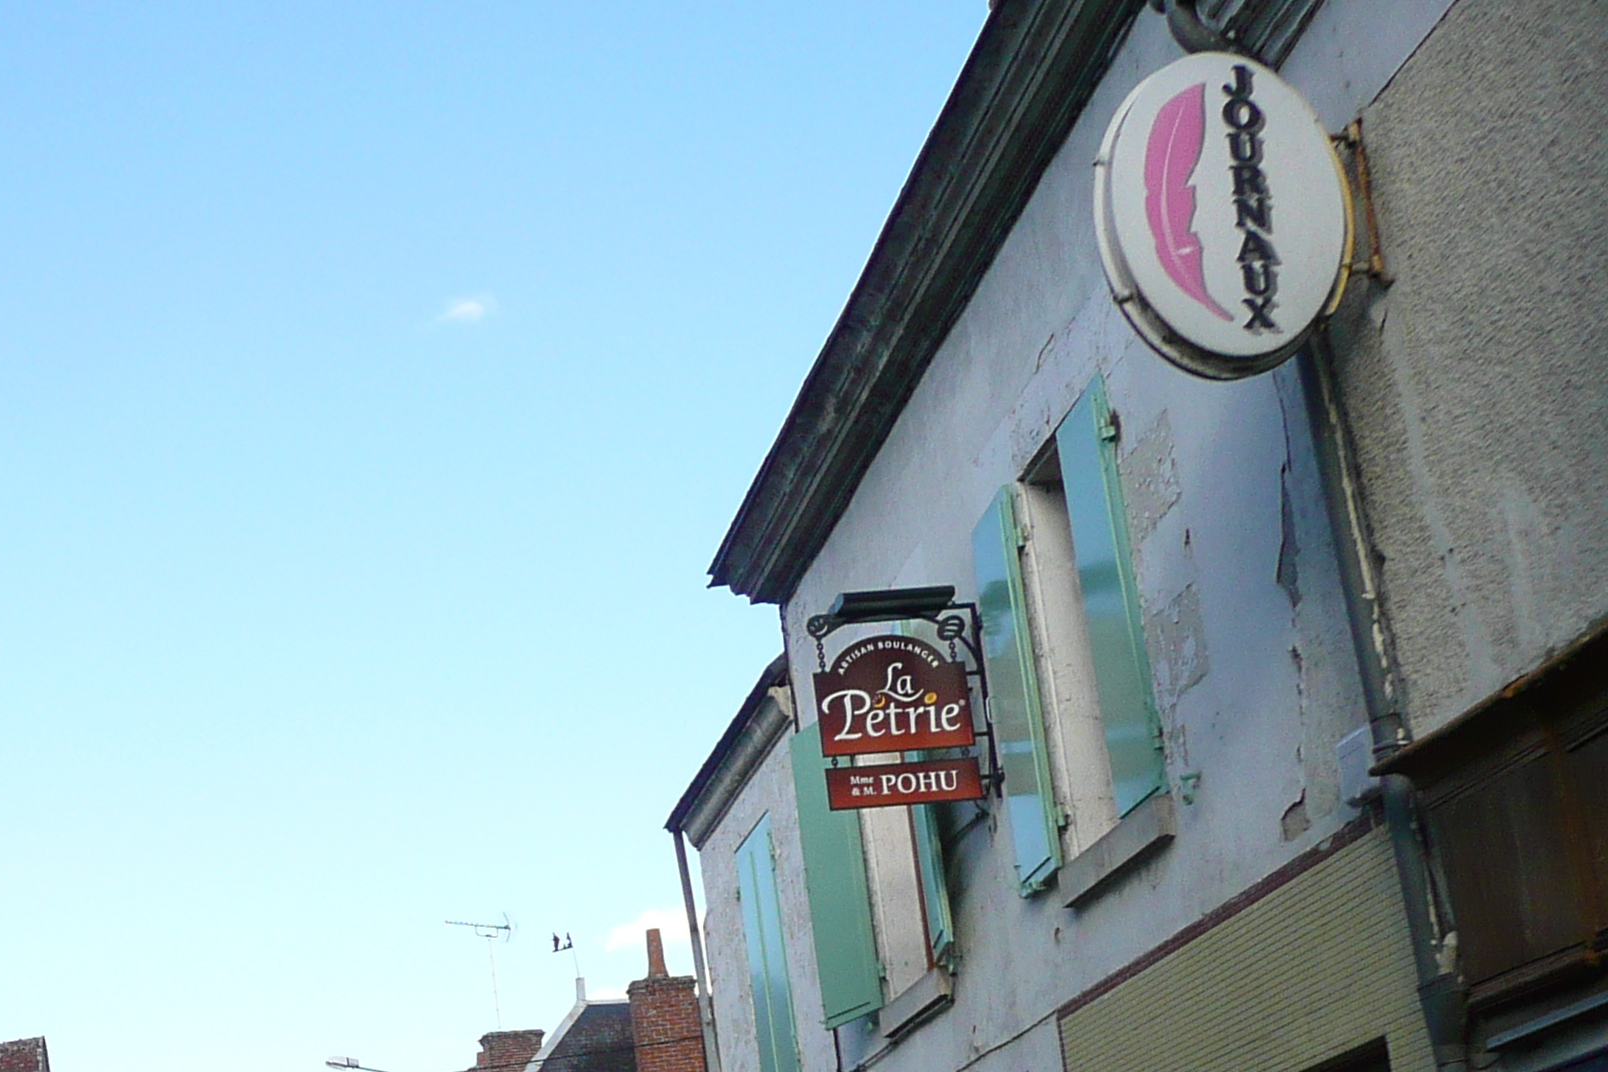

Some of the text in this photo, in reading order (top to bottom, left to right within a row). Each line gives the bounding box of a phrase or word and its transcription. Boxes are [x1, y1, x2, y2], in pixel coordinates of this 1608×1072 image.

[1221, 64, 1283, 335] JOURNAUX
[838, 640, 940, 676] ARTISAN BOULANGER
[876, 662, 924, 702] La
[850, 775, 874, 785] Mme
[879, 769, 959, 796] POHU
